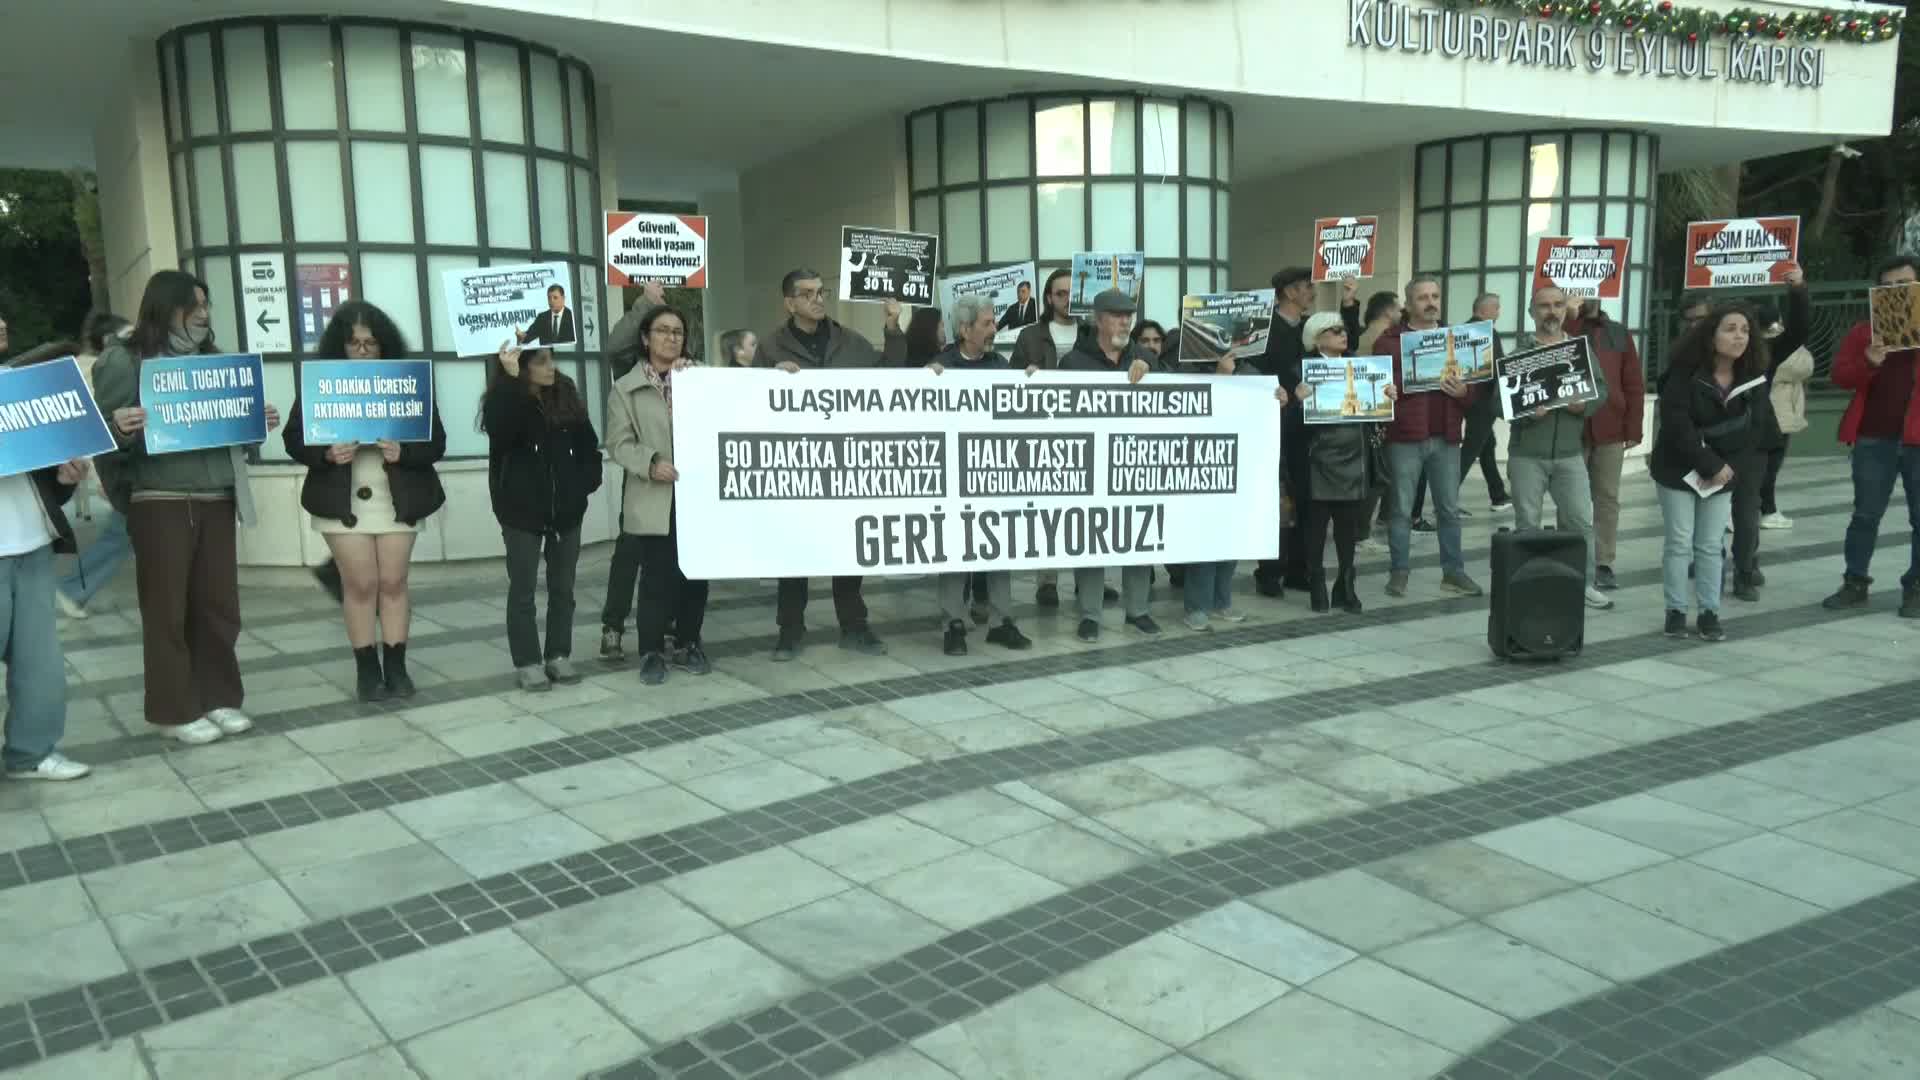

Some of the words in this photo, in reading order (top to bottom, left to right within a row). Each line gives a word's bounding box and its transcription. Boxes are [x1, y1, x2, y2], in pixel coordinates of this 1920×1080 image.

[1588, 28, 1606, 71] 9
[1729, 39, 1825, 86] KAPISI
[638, 221, 680, 236] Güvenli,
[622, 237, 662, 250] nitelikli
[664, 240, 695, 252] yaşam
[1695, 230, 1743, 252] ULAŞIM
[613, 253, 653, 266] alanları
[656, 254, 701, 268] istiyoruz!
[864, 277, 879, 291] 30
[882, 278, 895, 292] TL
[902, 282, 916, 297] 60
[919, 284, 929, 298] TL
[152, 371, 188, 393] CEMİL
[192, 368, 237, 390] TUGAY'A
[239, 367, 254, 387] DA
[319, 378, 333, 395] 90
[335, 376, 372, 395] DAKİKA
[374, 375, 417, 395] ÜCRETSİZ
[1557, 384, 1574, 398] 60
[1576, 380, 1591, 394] TL
[768, 388, 884, 420] ULAŞIMA
[889, 388, 990, 412] AYRILAN
[996, 384, 1072, 420] BÜTÇE
[1076, 389, 1209, 415] ARTTIRILSIN!
[1522, 392, 1535, 406] 30
[1537, 388, 1549, 401] TL
[313, 402, 363, 419] AKTARMA
[365, 400, 387, 418] GERİ
[389, 399, 424, 418] GELSİN!
[725, 440, 752, 468] 90
[759, 437, 837, 468] DAKİKA
[843, 436, 941, 468] ÜCRETSİZ
[966, 438, 1020, 469] HALK
[1026, 438, 1087, 474] TAŞIT
[1112, 435, 1189, 466] ÖĞRENCİ
[1193, 439, 1236, 465] KART
[724, 469, 825, 498] AKTARMA
[830, 468, 943, 497] HAKKIMIZI
[966, 470, 1088, 494] UYGULAMASINI
[1112, 466, 1235, 492] UYGULAMASINI
[855, 505, 948, 568] GERİ
[960, 501, 1165, 563] İSTİYORUZ!
